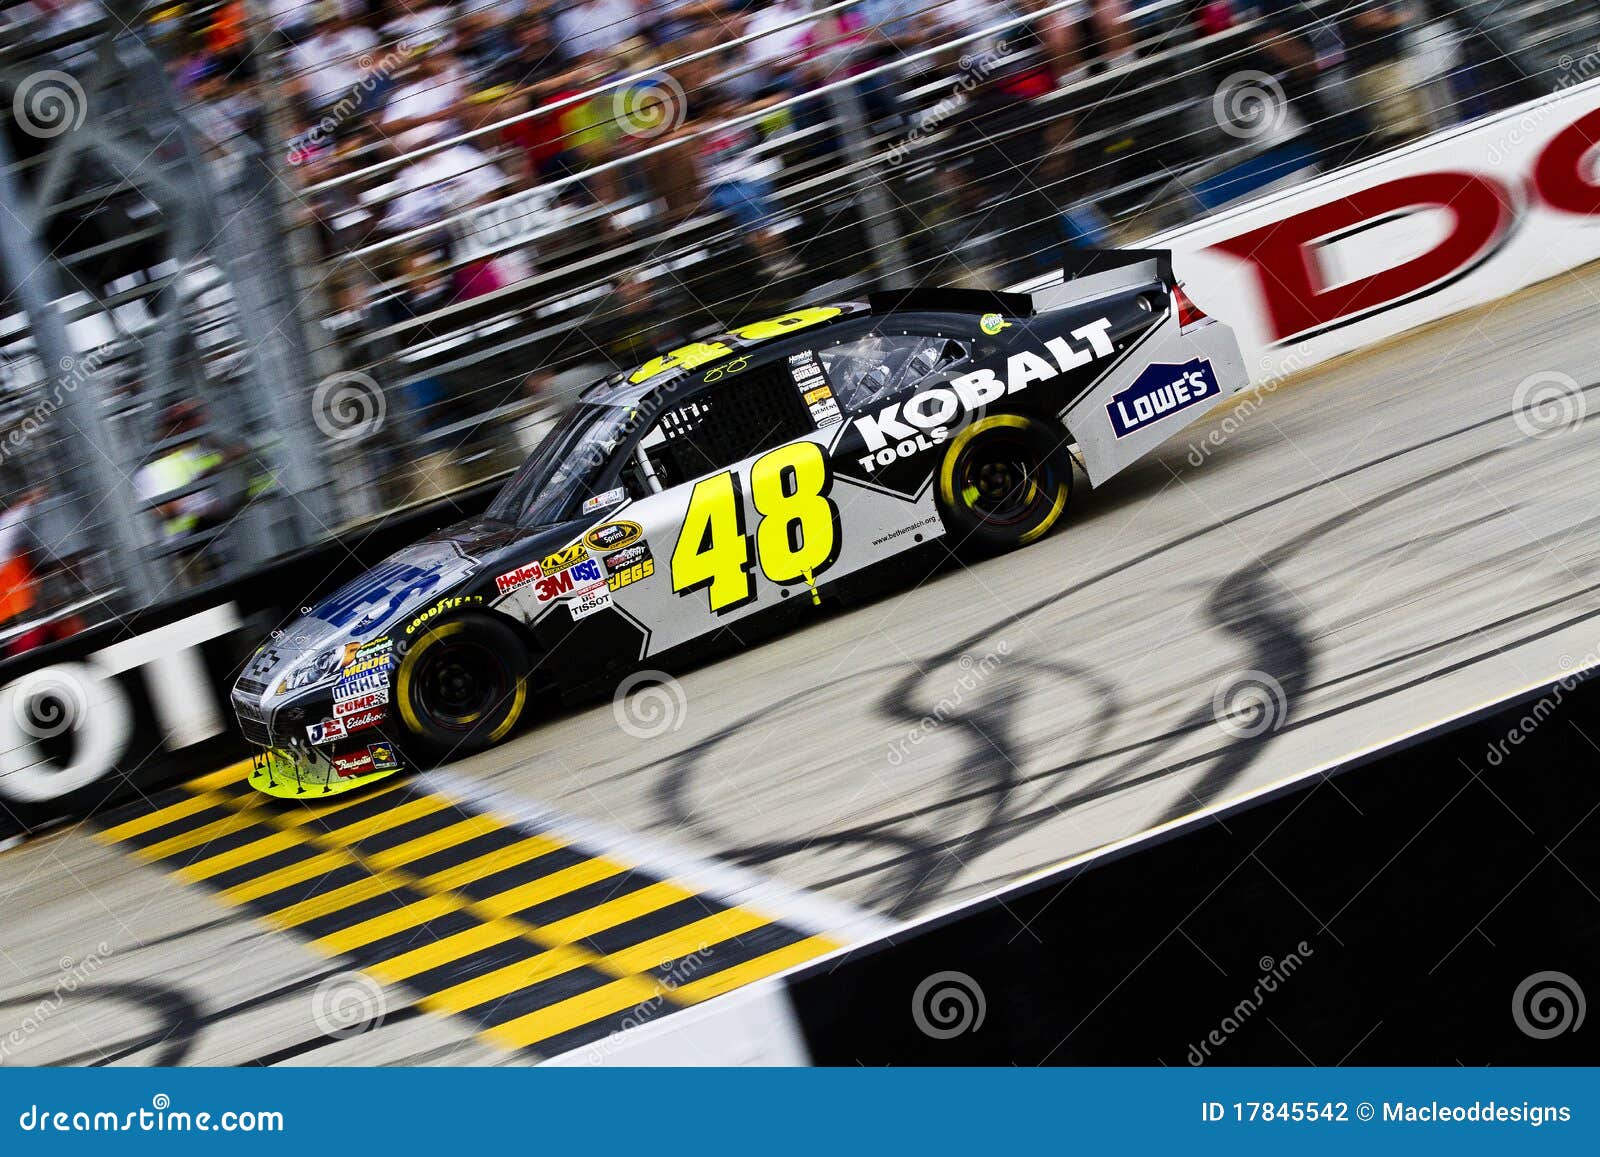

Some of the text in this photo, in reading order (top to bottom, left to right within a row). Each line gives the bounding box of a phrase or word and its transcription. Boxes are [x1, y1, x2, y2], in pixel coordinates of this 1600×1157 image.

[854, 317, 1116, 453] KOBALT
[1117, 370, 1208, 429] LOWE'S
[857, 425, 950, 473] TOOLS
[603, 530, 624, 545] Sprint
[670, 441, 842, 615] 48
[872, 515, 936, 547] www.bethematch.org
[496, 565, 543, 589] Holley
[570, 558, 600, 582] USG
[608, 558, 655, 592] JEGS
[534, 569, 575, 602] 3M
[571, 595, 610, 616] TISSOT
[343, 653, 391, 678] MOOG
[334, 671, 389, 700] MAHLE
[335, 694, 375, 715] COMP
[311, 719, 342, 743] JE
